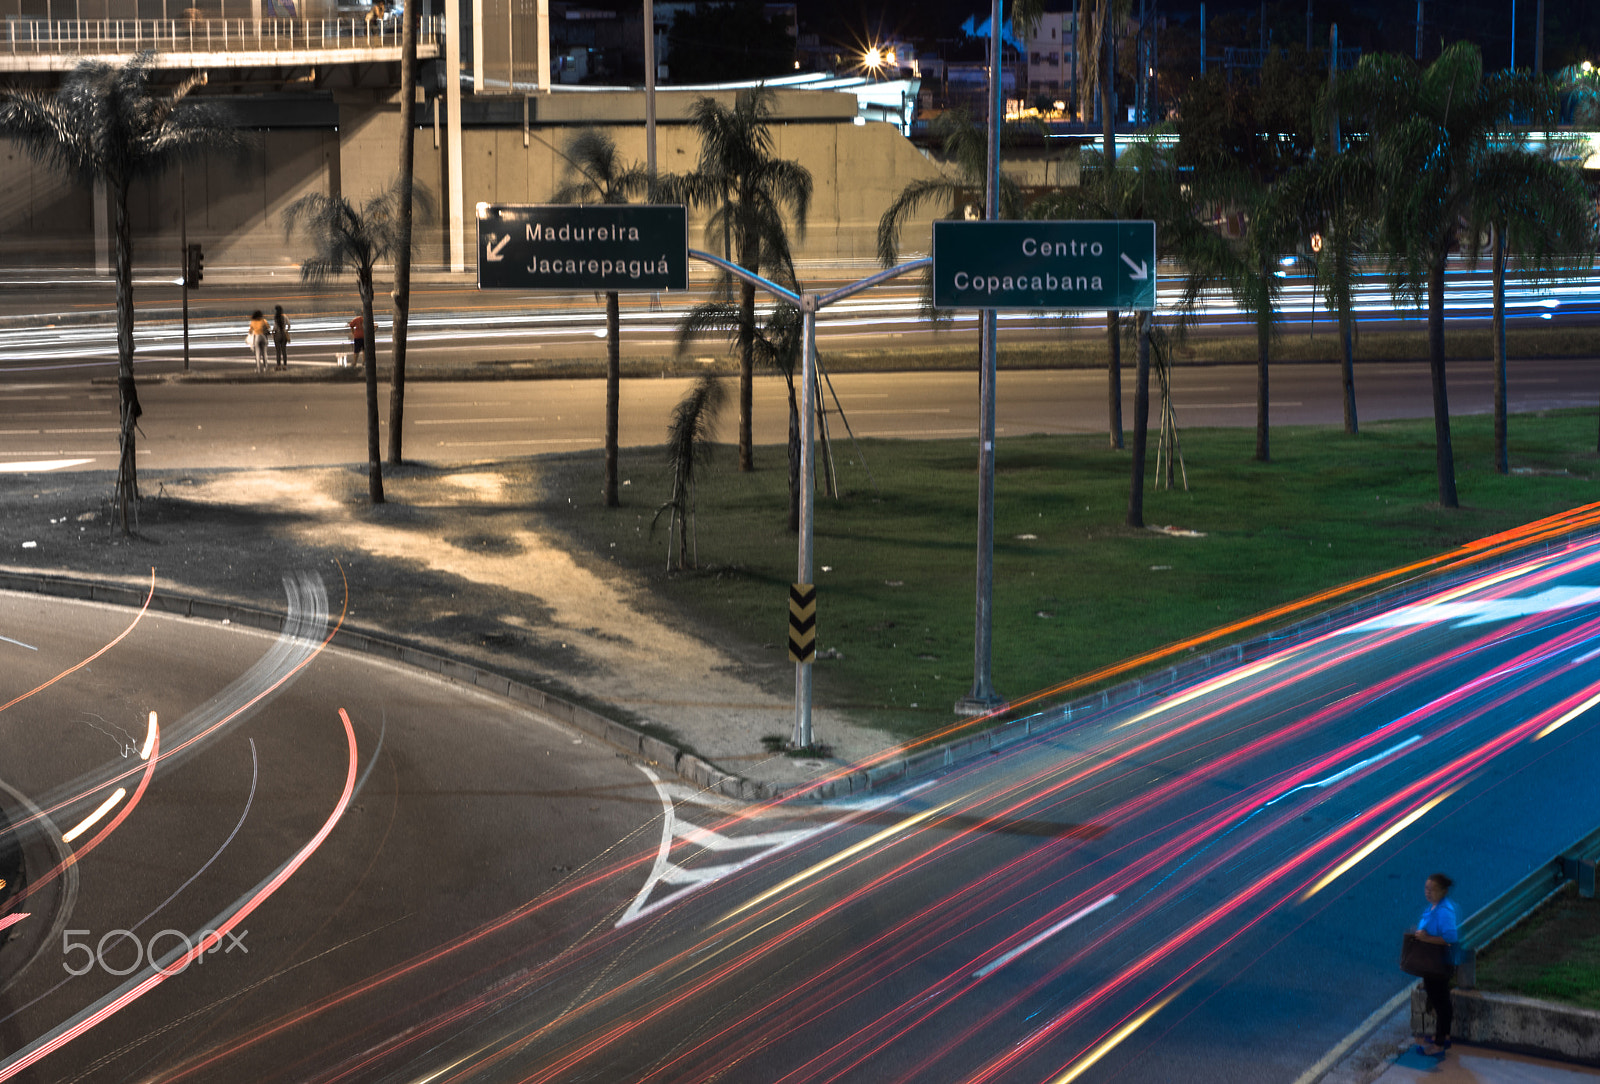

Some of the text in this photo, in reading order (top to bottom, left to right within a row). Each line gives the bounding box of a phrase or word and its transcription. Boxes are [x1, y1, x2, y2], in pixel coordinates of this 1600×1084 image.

[525, 223, 640, 241] Madureira
[1022, 237, 1103, 257] Centro
[527, 254, 669, 278] Jacarepaguá
[954, 271, 1103, 294] Copacabana
